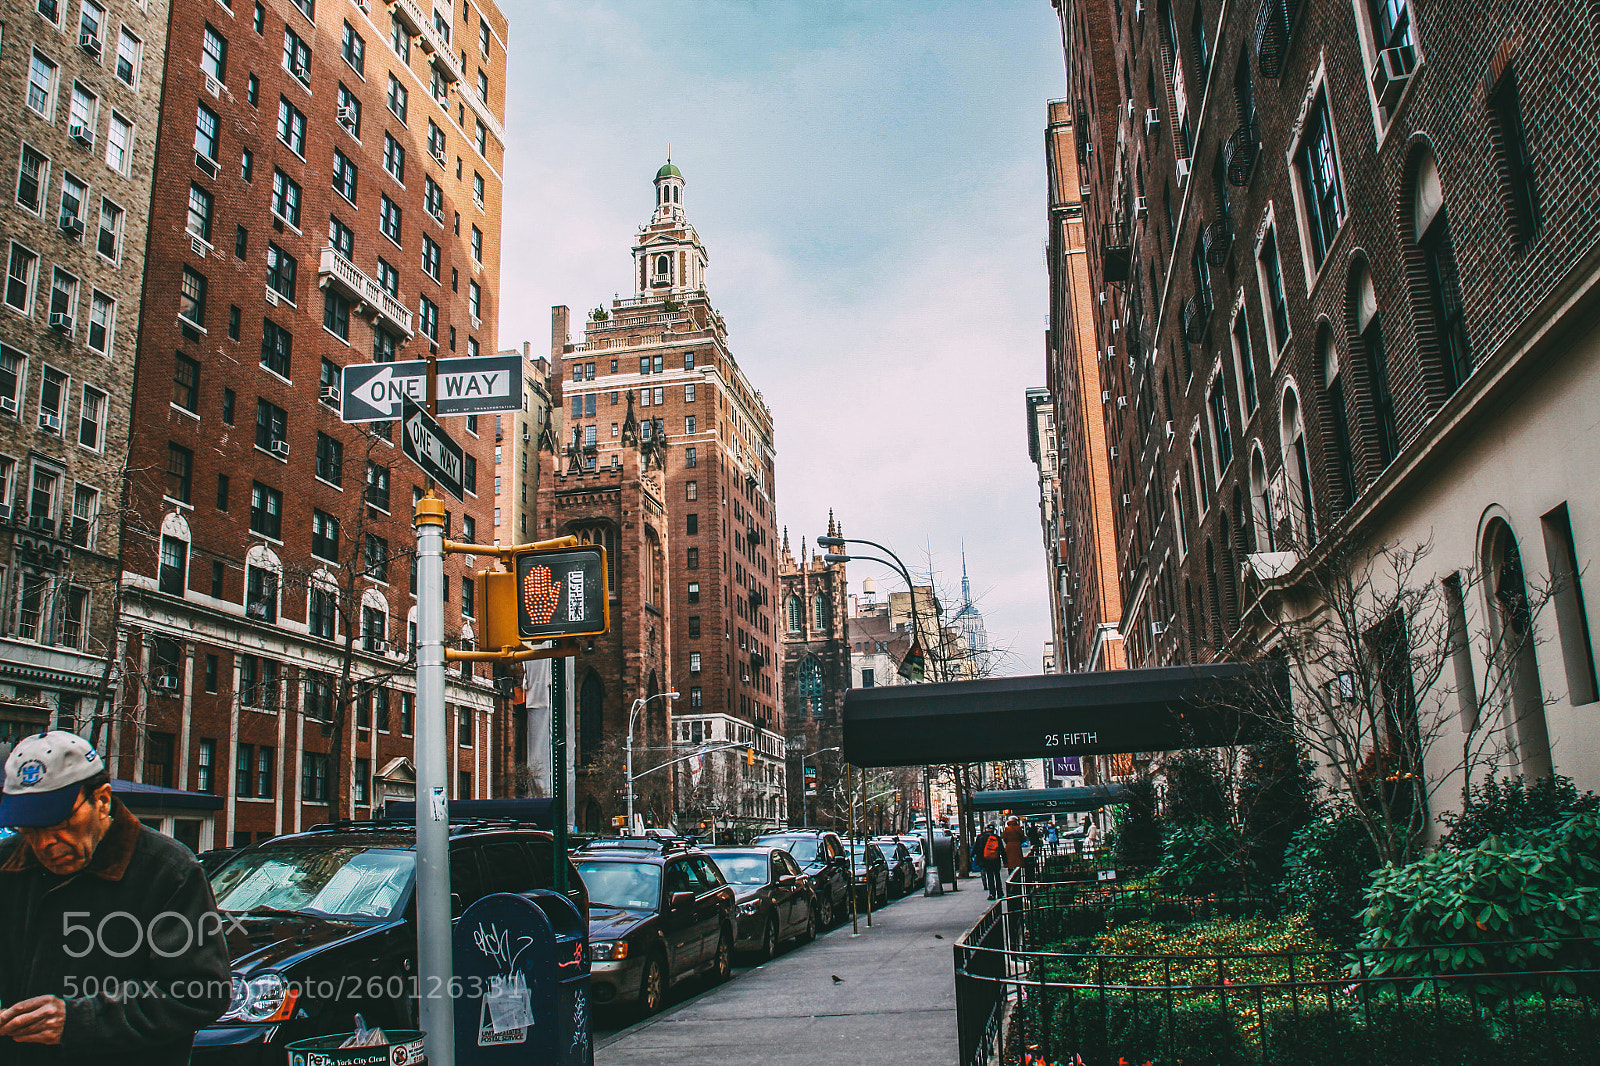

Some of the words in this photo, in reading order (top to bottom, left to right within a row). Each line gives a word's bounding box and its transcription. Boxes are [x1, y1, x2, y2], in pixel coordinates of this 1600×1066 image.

[371, 379, 420, 402] ONE
[445, 373, 499, 397] WAY
[413, 421, 432, 456] ONE
[440, 444, 457, 478] WAY
[1045, 734, 1059, 747] 25
[1063, 731, 1098, 746] FIFTH
[1057, 763, 1076, 772] NYU
[337, 1058, 352, 1066] York
[353, 1056, 367, 1066] City
[368, 1055, 387, 1064] Clean
